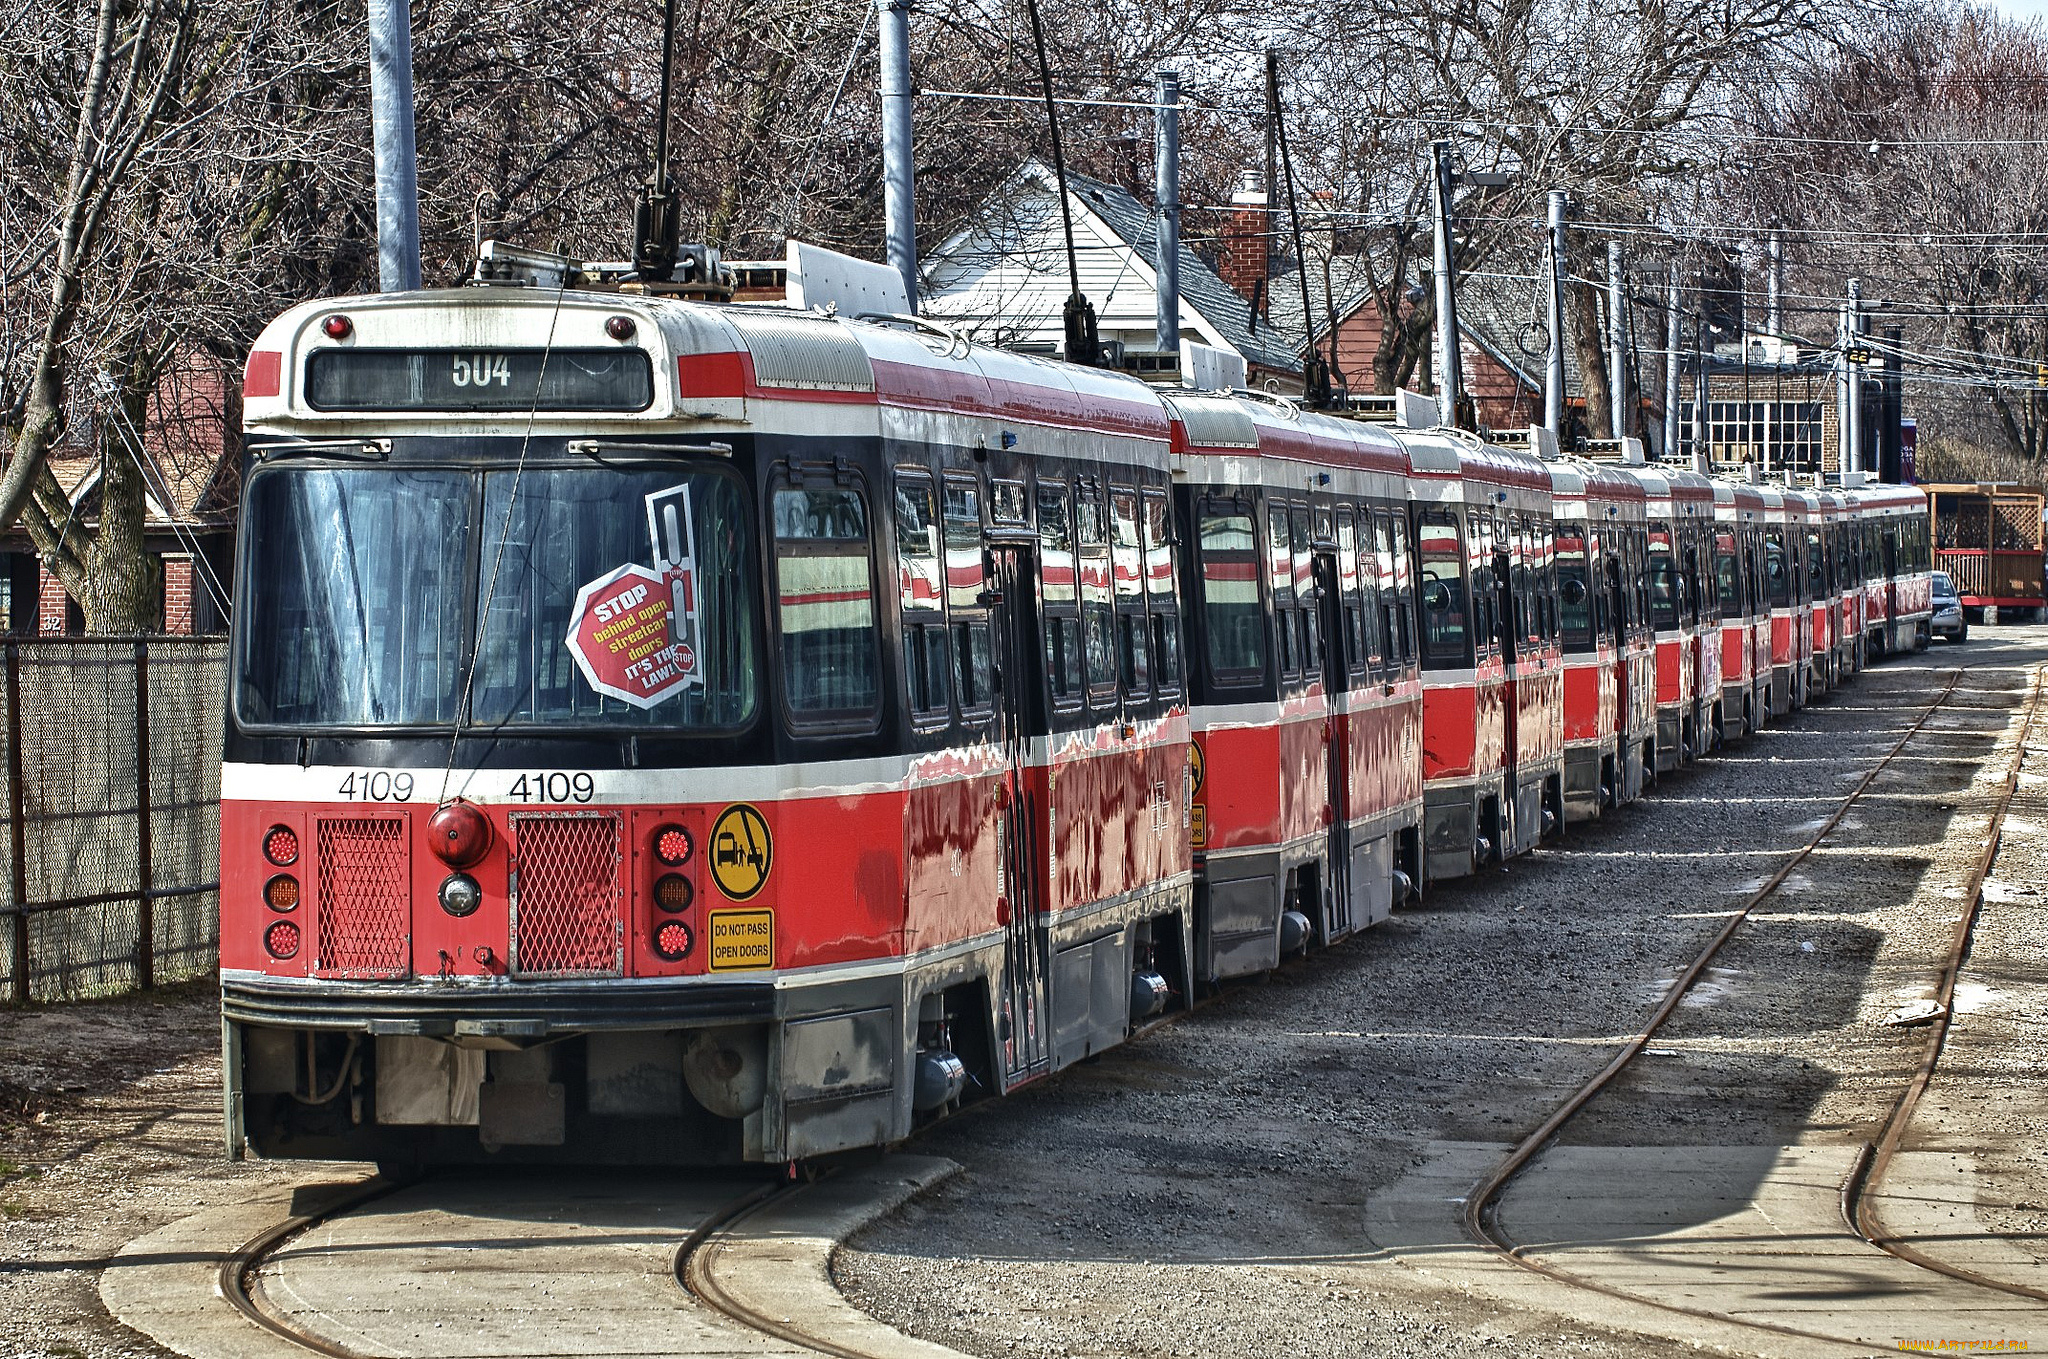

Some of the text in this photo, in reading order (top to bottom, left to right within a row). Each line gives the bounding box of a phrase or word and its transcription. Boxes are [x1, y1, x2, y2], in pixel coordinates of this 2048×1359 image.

[453, 354, 510, 386] 504
[593, 584, 648, 623] STOP
[592, 600, 668, 644] behind open
[609, 617, 666, 654] streetcar
[624, 644, 678, 681] IT'S THE
[628, 637, 664, 661] doors
[674, 653, 692, 663] STOP
[641, 663, 675, 690] LAW!
[338, 771, 415, 802] 4109
[509, 772, 595, 803] 4109
[715, 922, 768, 936] DO NOT PASS
[715, 944, 768, 958] OPEN DOORS
